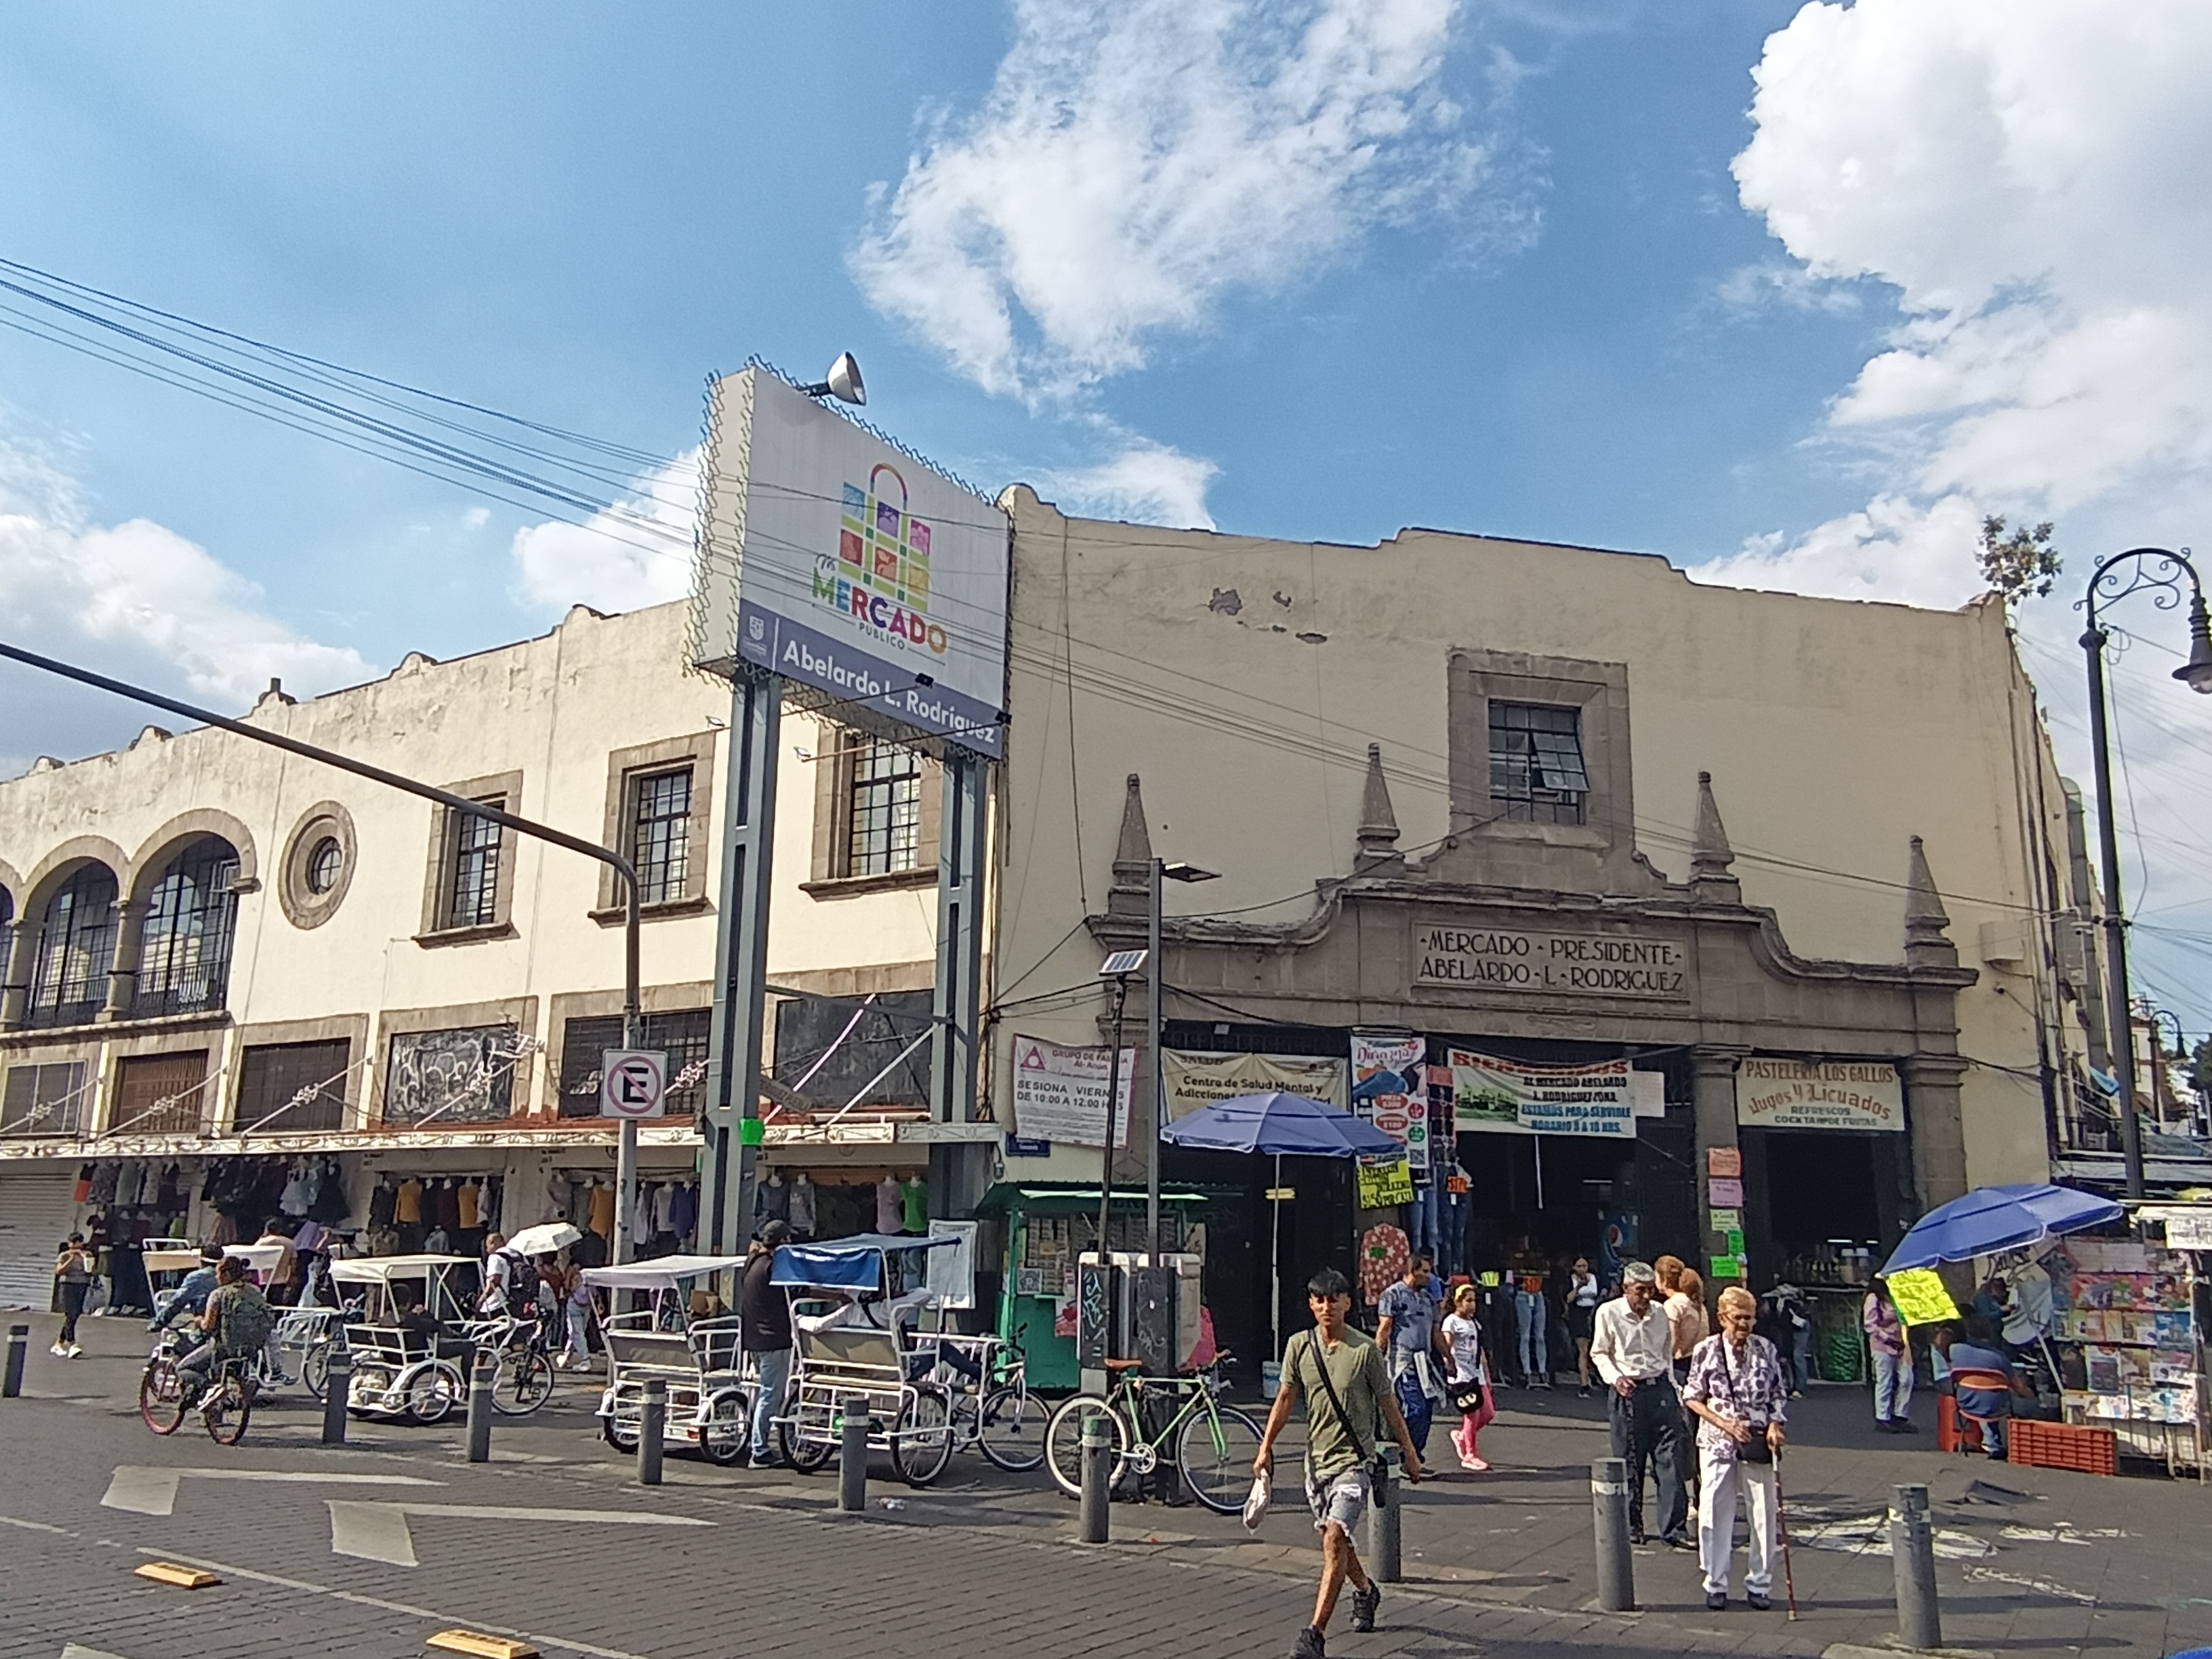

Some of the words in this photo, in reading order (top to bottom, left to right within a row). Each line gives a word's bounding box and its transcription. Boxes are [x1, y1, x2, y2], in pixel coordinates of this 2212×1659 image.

[813, 567, 947, 654] MERCADO
[783, 640, 881, 697] Abelardo
[884, 680, 901, 708] L.
[906, 690, 996, 743] Rodríguez
[1428, 930, 1530, 956] MERCADO
[1551, 939, 1675, 966] PRESIDENTE
[1420, 956, 1530, 983] ABELARDO
[1544, 965, 1557, 985] L
[1570, 966, 1683, 991] RODRIGUEZ
[1052, 1049, 1082, 1060] GRUPO
[1083, 1051, 1094, 1061] DE
[1096, 1053, 1128, 1064] FAMIA
[1581, 1076, 1627, 1088] ABELARDO
[1824, 1065, 1847, 1082] LOS
[1849, 1065, 1894, 1084] GALLOS
[622, 1066, 649, 1103] E
[1017, 1079, 1068, 1094] SESIONA
[1076, 1086, 1125, 1099] VIERNS
[1175, 1087, 1236, 1100] Adicciones
[1183, 1076, 1225, 1088] Centro
[1226, 1079, 1238, 1088] de
[1240, 1079, 1273, 1090] Salud
[1274, 1081, 1314, 1093] Mental
[1315, 1085, 1323, 1095] y
[1017, 1091, 1031, 1101] DE
[1034, 1093, 1061, 1105] 10:00
[1061, 1096, 1071, 1106] A
[1073, 1097, 1100, 1109] 12:00
[1101, 1101, 1124, 1111] HS
[1748, 1090, 1793, 1115] Jugos
[1807, 1083, 1892, 1120] Licuados
[1790, 1105, 1851, 1116] REFRESCOS
[1521, 1104, 1564, 1117] ESTAMOS
[1565, 1106, 1589, 1118] PARA
[1531, 1120, 1572, 1132] HORARIO
[1581, 1121, 1588, 1132] A
[1842, 1117, 1877, 1126] FRUTAS
